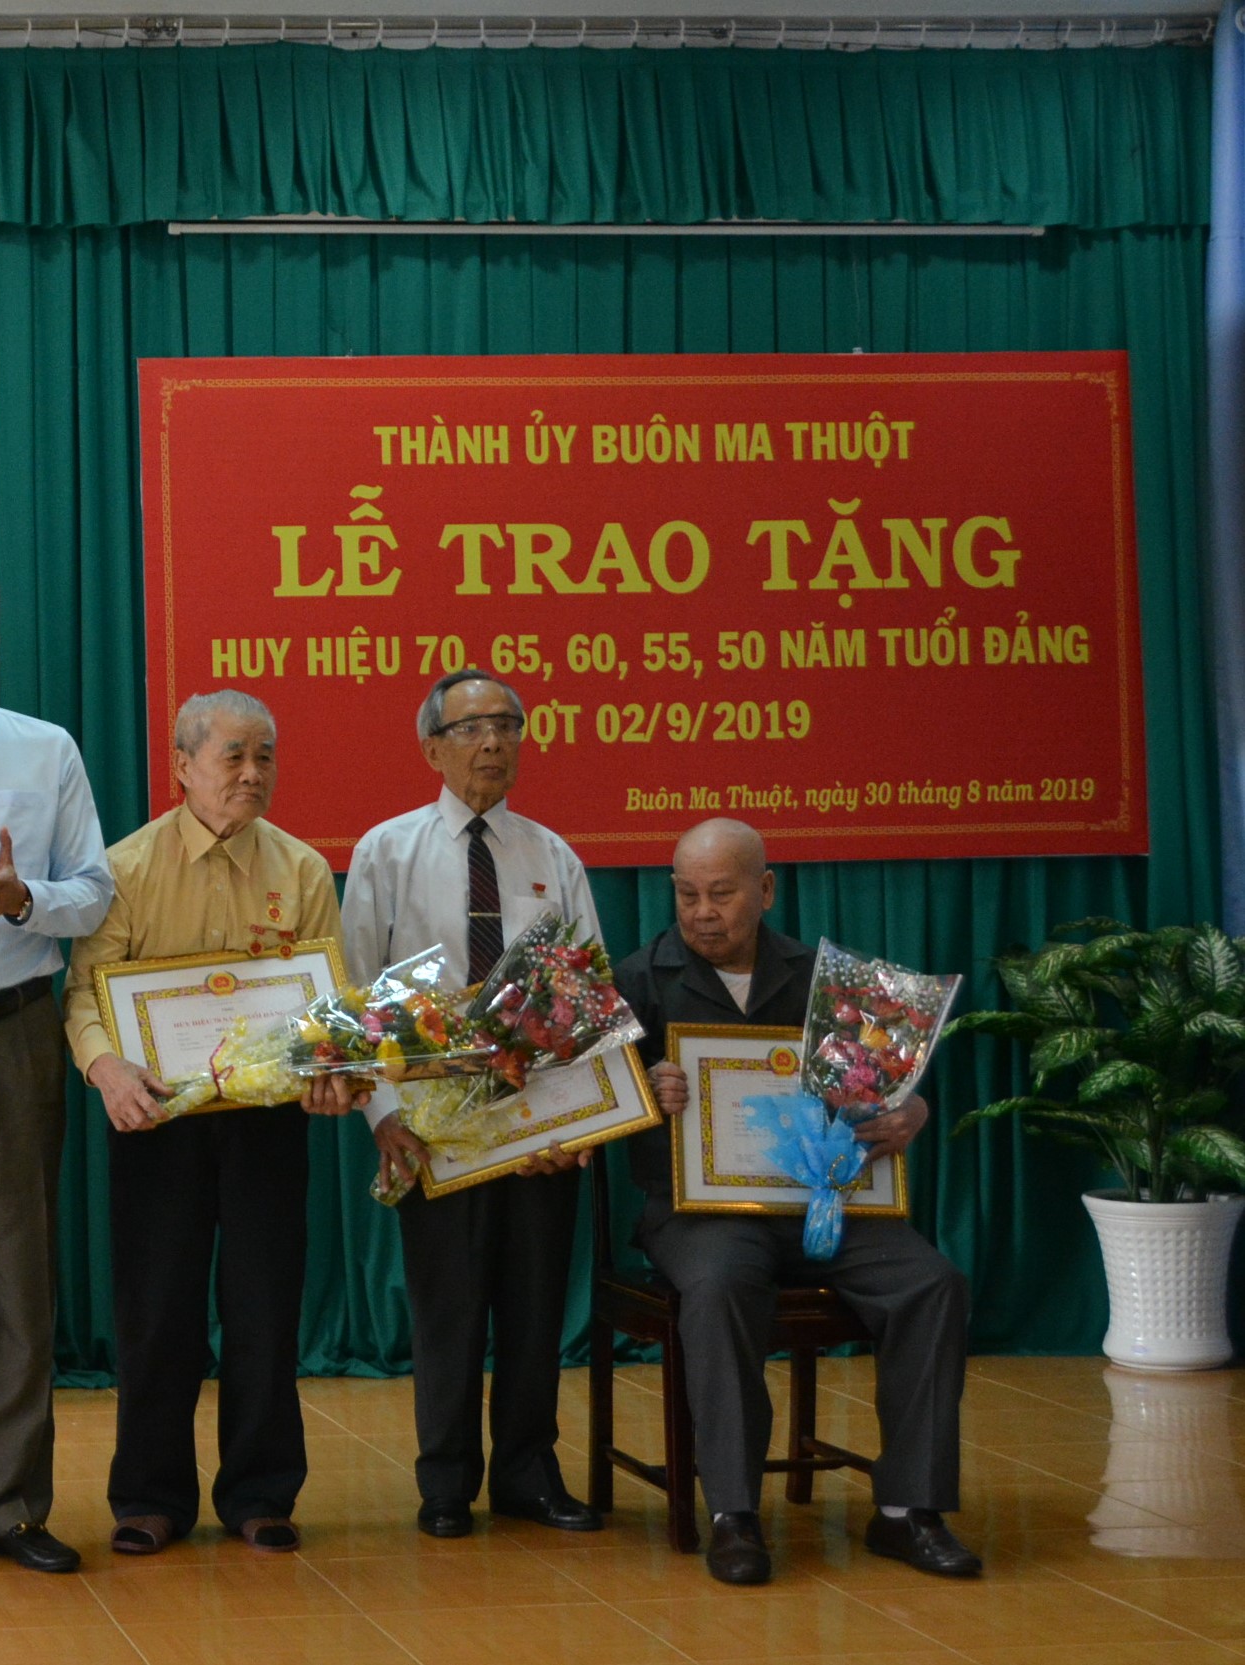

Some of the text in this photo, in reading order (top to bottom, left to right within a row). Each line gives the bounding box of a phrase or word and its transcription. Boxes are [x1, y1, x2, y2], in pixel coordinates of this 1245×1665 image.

[373, 410, 914, 467] THÀNH ỦY BUÔN MA THUỘT
[272, 485, 1020, 609] LỄ TRAO TẶNG
[212, 638, 291, 678] HUY
[307, 626, 400, 684] HIỆU
[491, 635, 552, 681] 65,
[567, 634, 627, 680] 60,
[644, 633, 702, 678] 55,
[719, 631, 765, 670] 50
[781, 622, 865, 668] NĂM
[879, 606, 968, 666] TUỔI
[983, 611, 1088, 663] ĐẢNG
[597, 700, 810, 743] 02/9/2019
[627, 779, 1093, 812] Buôn Ma Thuột, ngày 30 tháng 8 năm 2019
